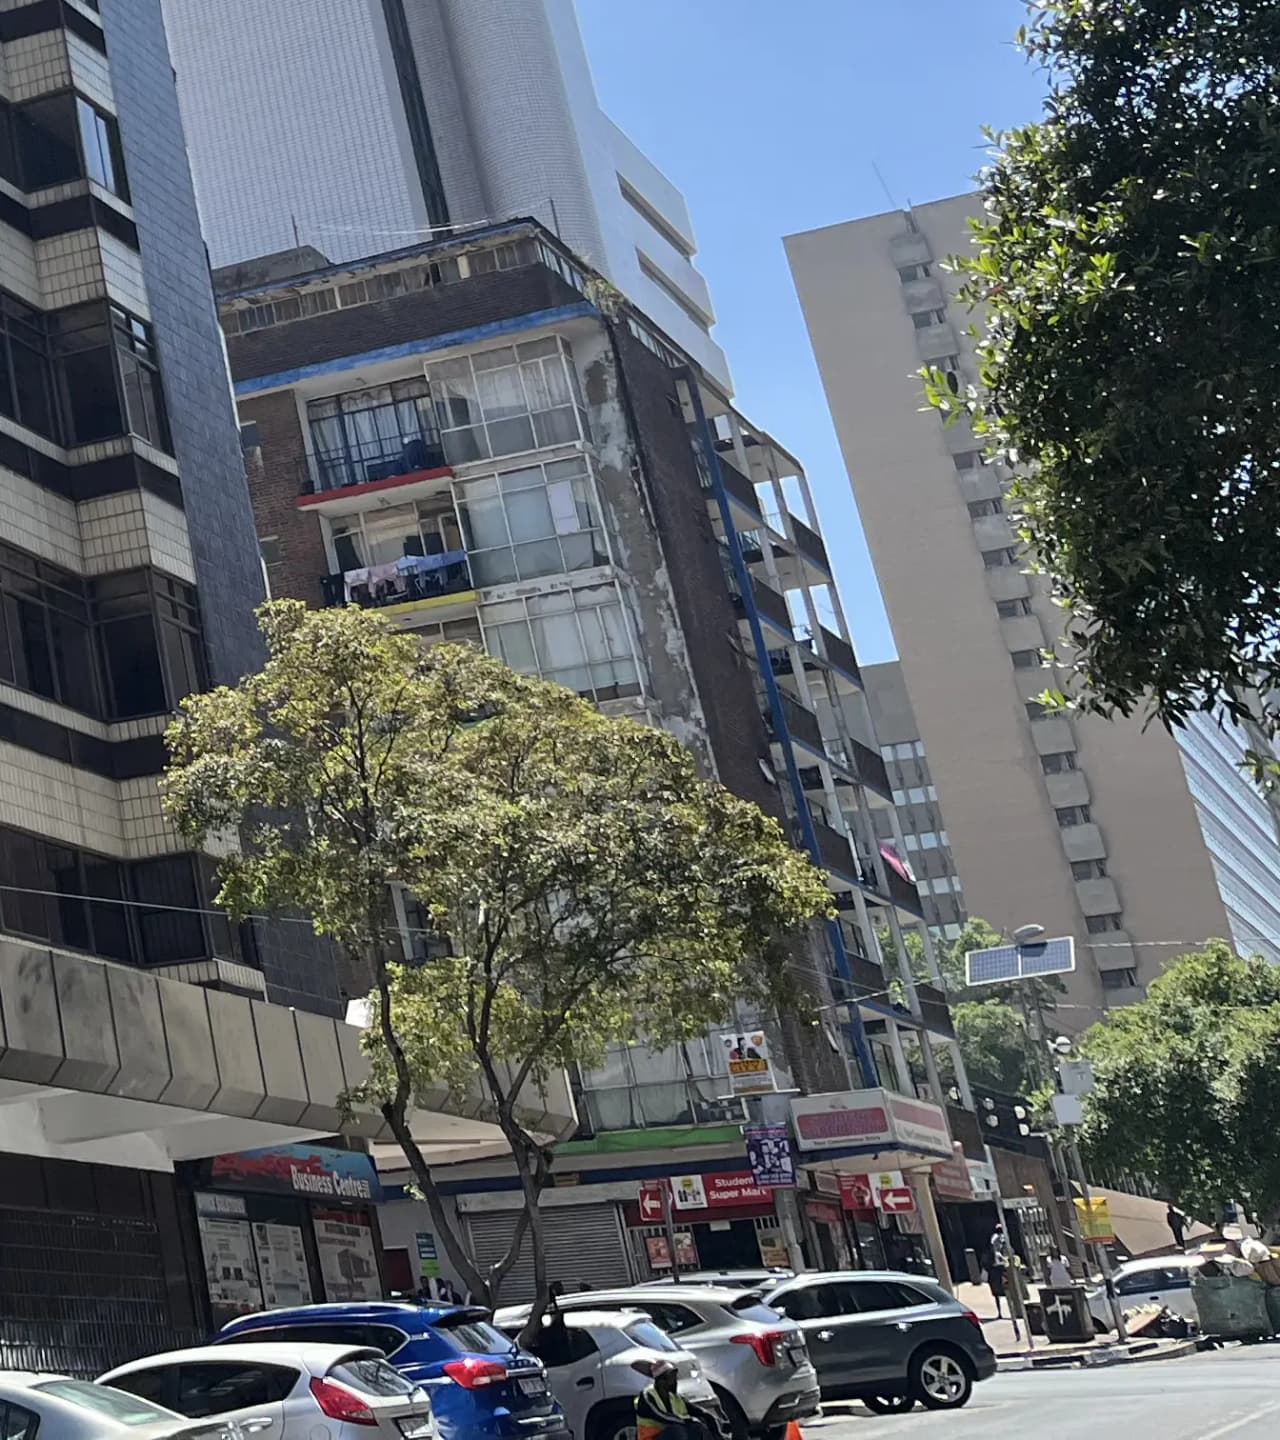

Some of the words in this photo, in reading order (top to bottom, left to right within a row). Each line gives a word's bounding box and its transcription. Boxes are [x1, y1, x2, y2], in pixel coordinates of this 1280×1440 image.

[290, 1164, 333, 1194] Business
[333, 1170, 363, 1198] Centre
[715, 1175, 755, 1188] Student
[709, 1190, 739, 1201] Super
